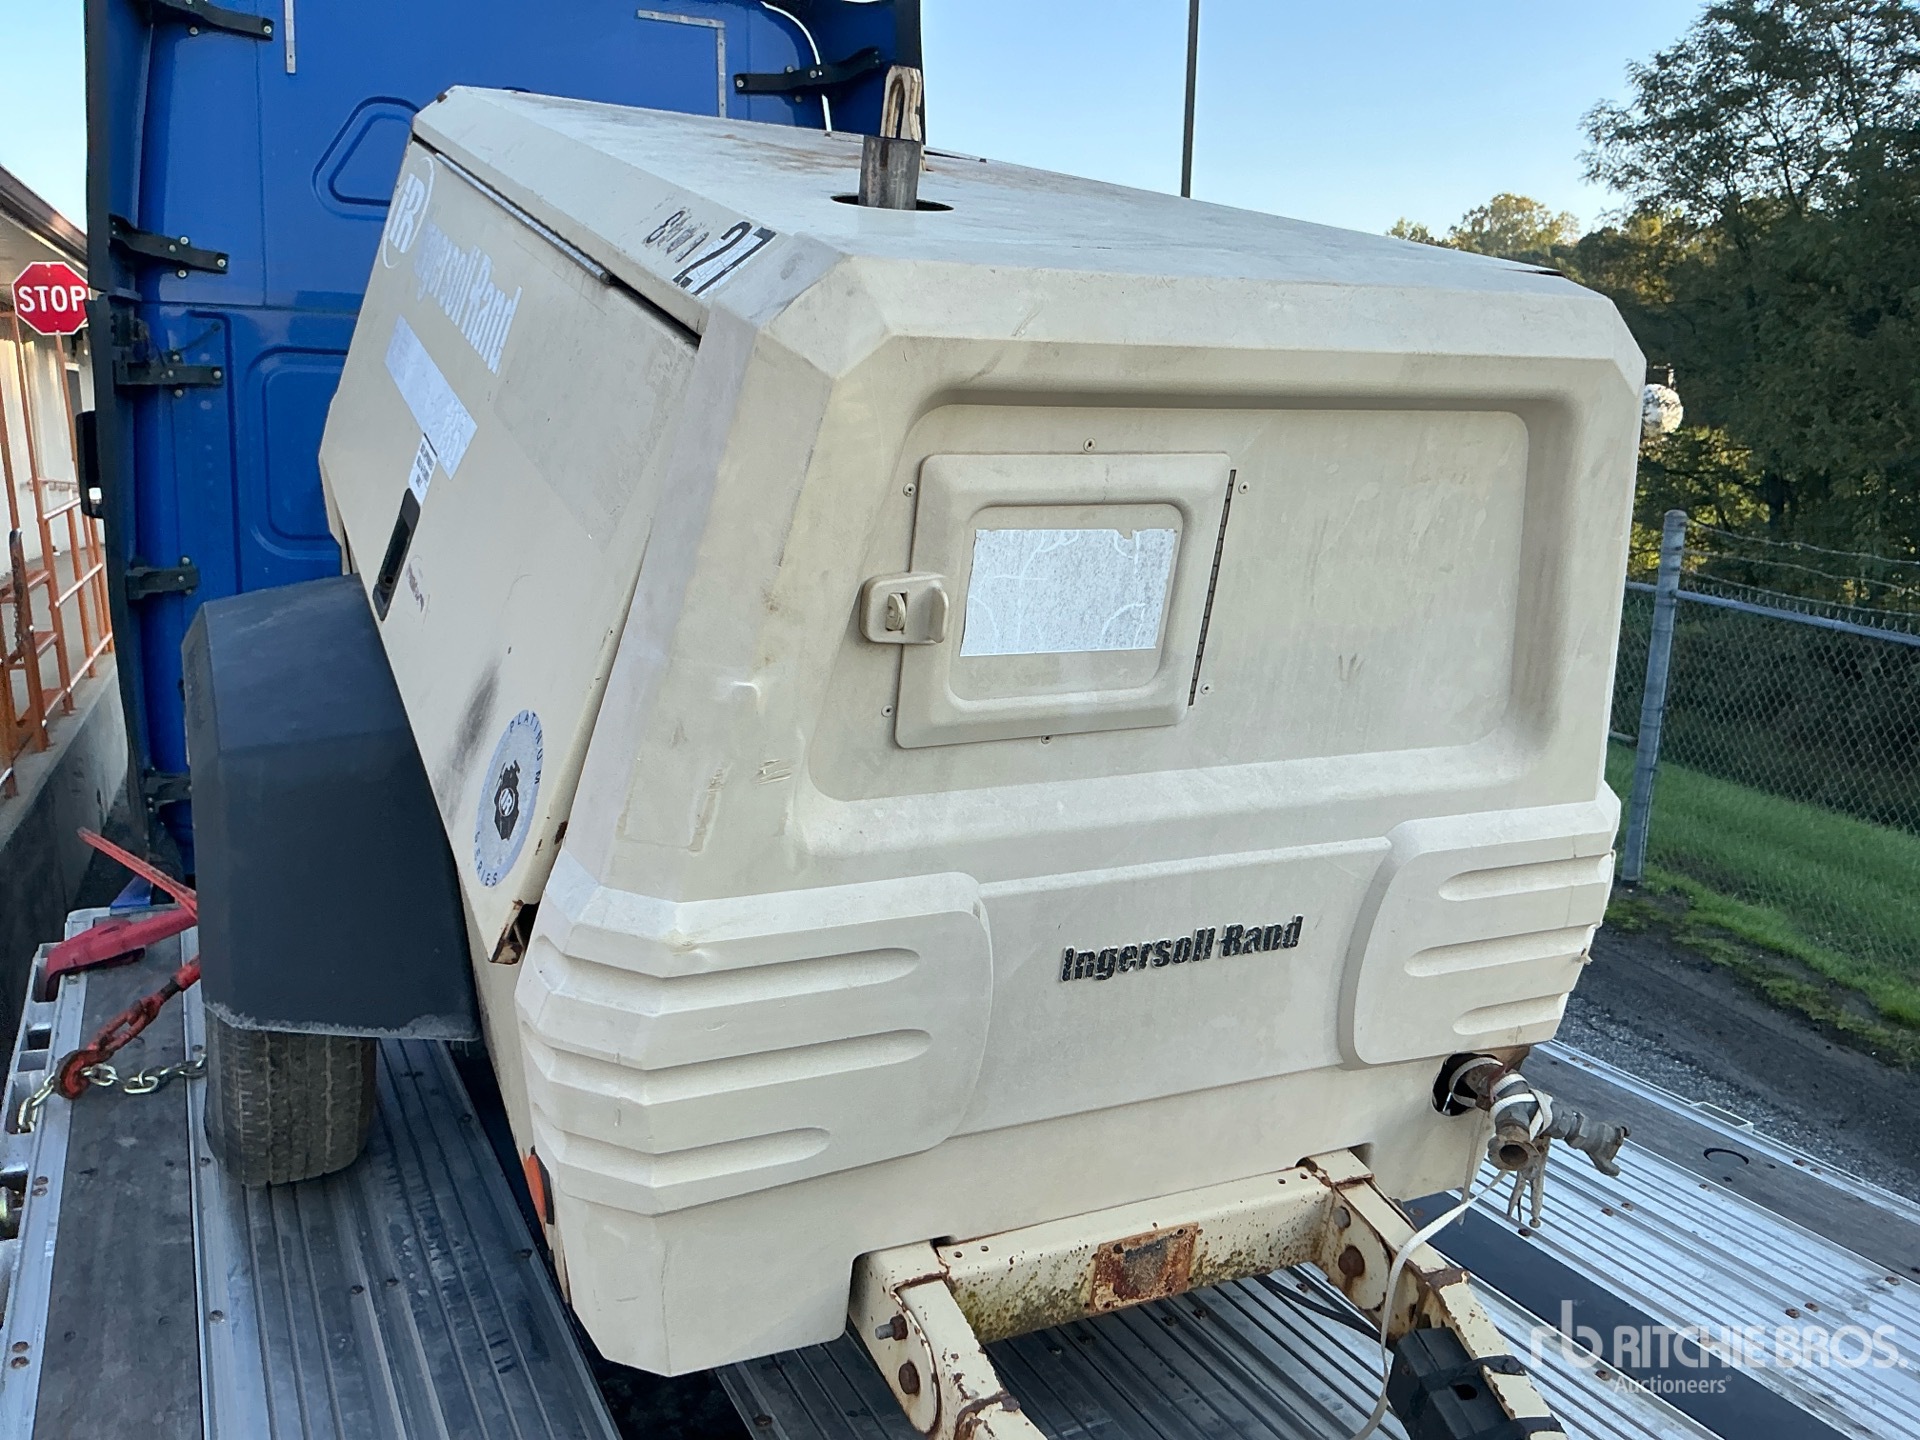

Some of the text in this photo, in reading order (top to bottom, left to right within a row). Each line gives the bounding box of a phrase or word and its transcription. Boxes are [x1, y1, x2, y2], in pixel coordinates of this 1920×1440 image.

[672, 221, 777, 297] 27
[18, 285, 87, 313] STOP
[461, 253, 522, 378] Rand
[509, 711, 543, 786] PLATINUM
[474, 830, 499, 887] SERIES
[1060, 925, 1216, 982] Ingersoll
